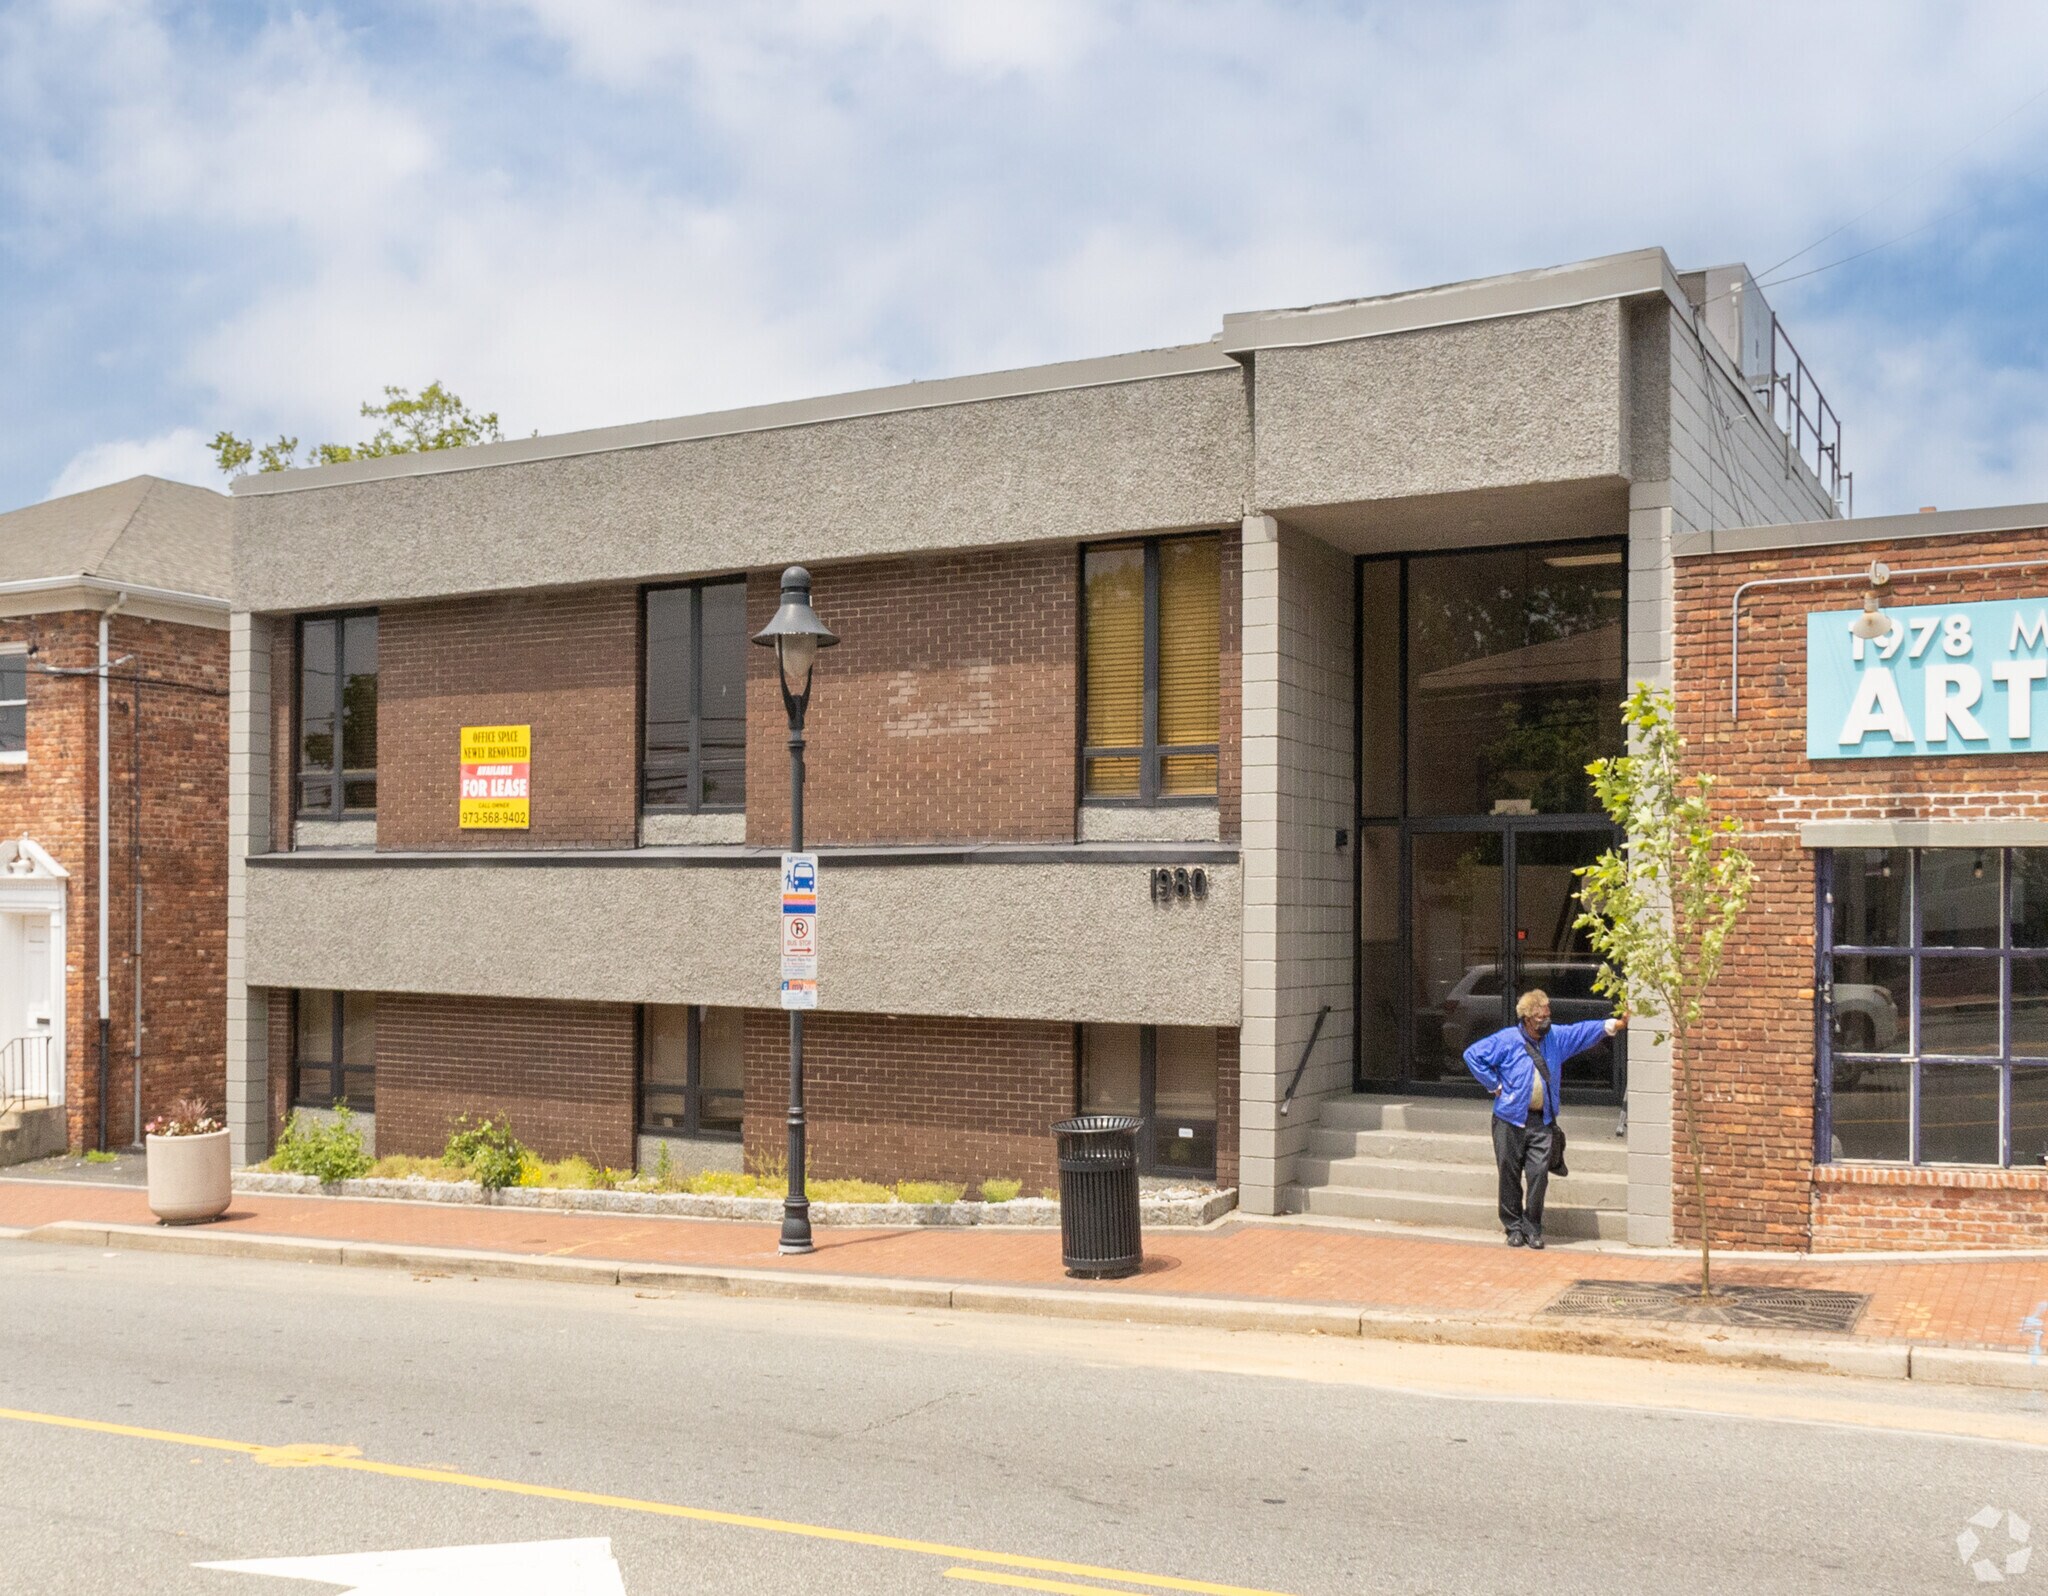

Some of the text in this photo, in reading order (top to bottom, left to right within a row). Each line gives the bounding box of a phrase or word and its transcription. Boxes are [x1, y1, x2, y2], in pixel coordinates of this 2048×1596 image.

[1848, 613, 1973, 661] 1978
[1838, 659, 2047, 745] ART
[472, 730, 518, 744] OFFICE SPACE
[463, 746, 528, 759] NEWLY RENOVATED
[476, 765, 513, 776] AVAILABLE
[462, 778, 527, 797] FOR LEASE
[462, 811, 526, 824] 973-568-9402
[1151, 868, 1207, 902] 1980
